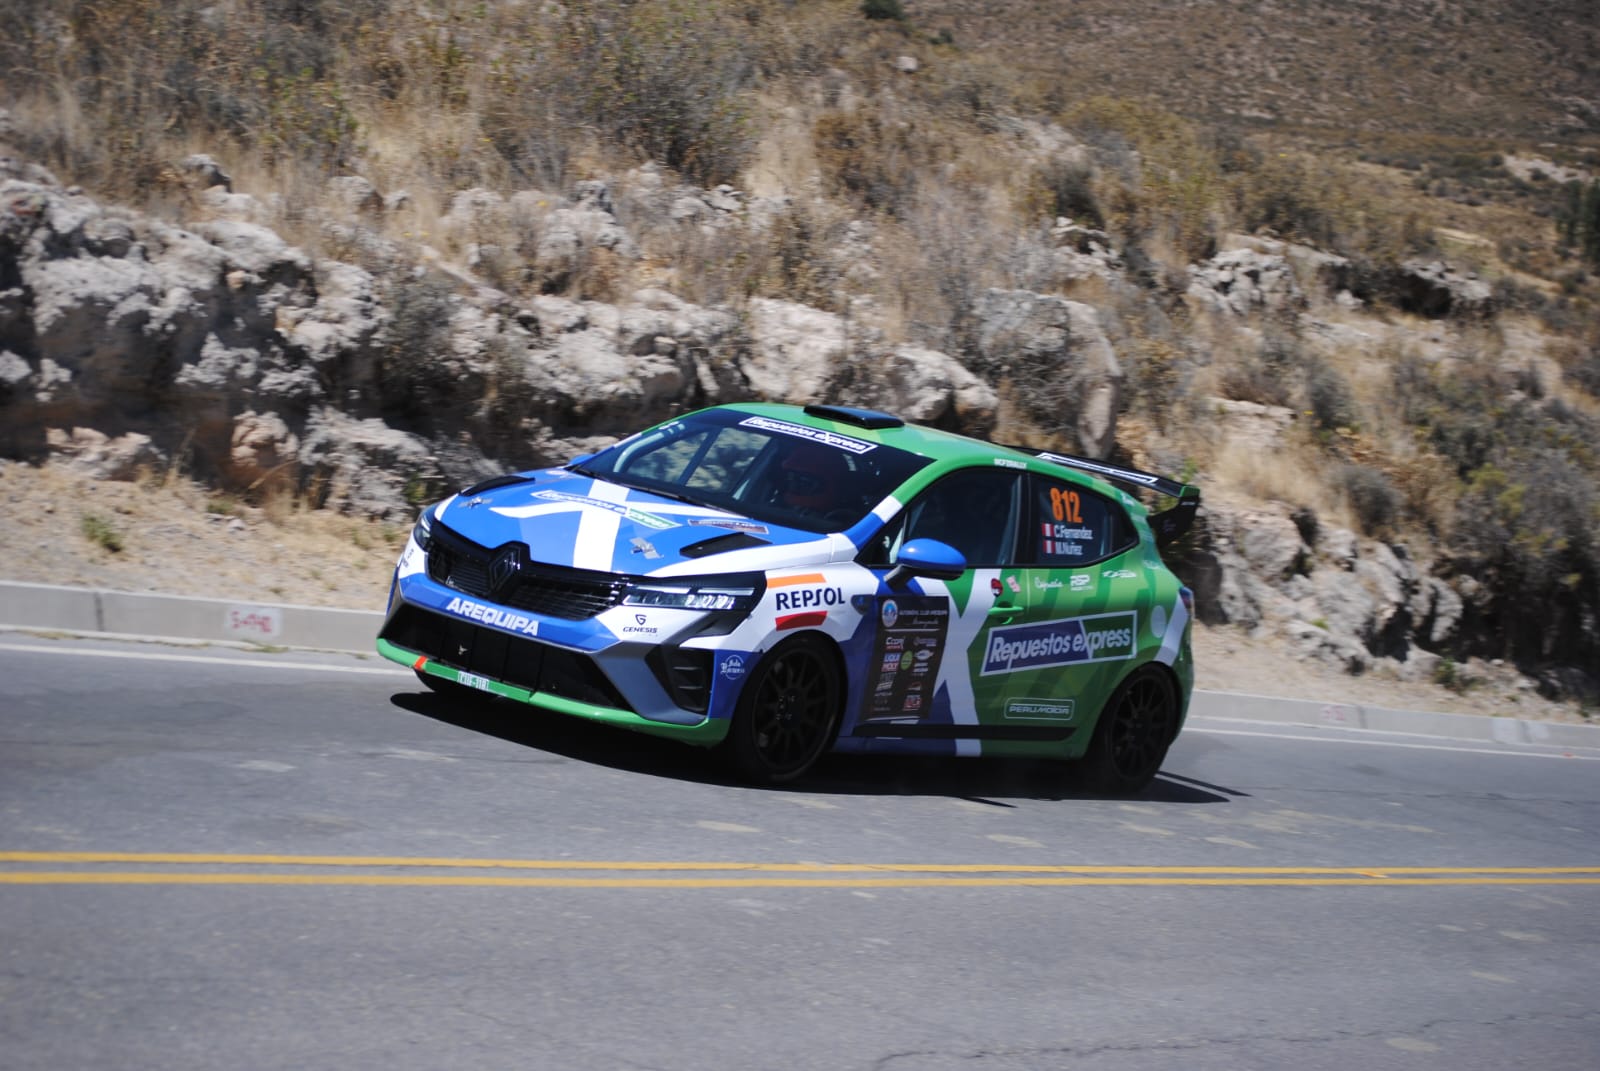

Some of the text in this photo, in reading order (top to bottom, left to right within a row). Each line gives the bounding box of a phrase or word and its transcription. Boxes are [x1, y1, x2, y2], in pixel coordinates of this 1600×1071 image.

[748, 418, 867, 450] Repuestos express
[1050, 487, 1084, 524] 812
[446, 597, 540, 636] AREQUIPA
[775, 587, 846, 612] REPSOL
[622, 626, 658, 635] GENESIS
[988, 627, 1132, 666] Repuestos express
